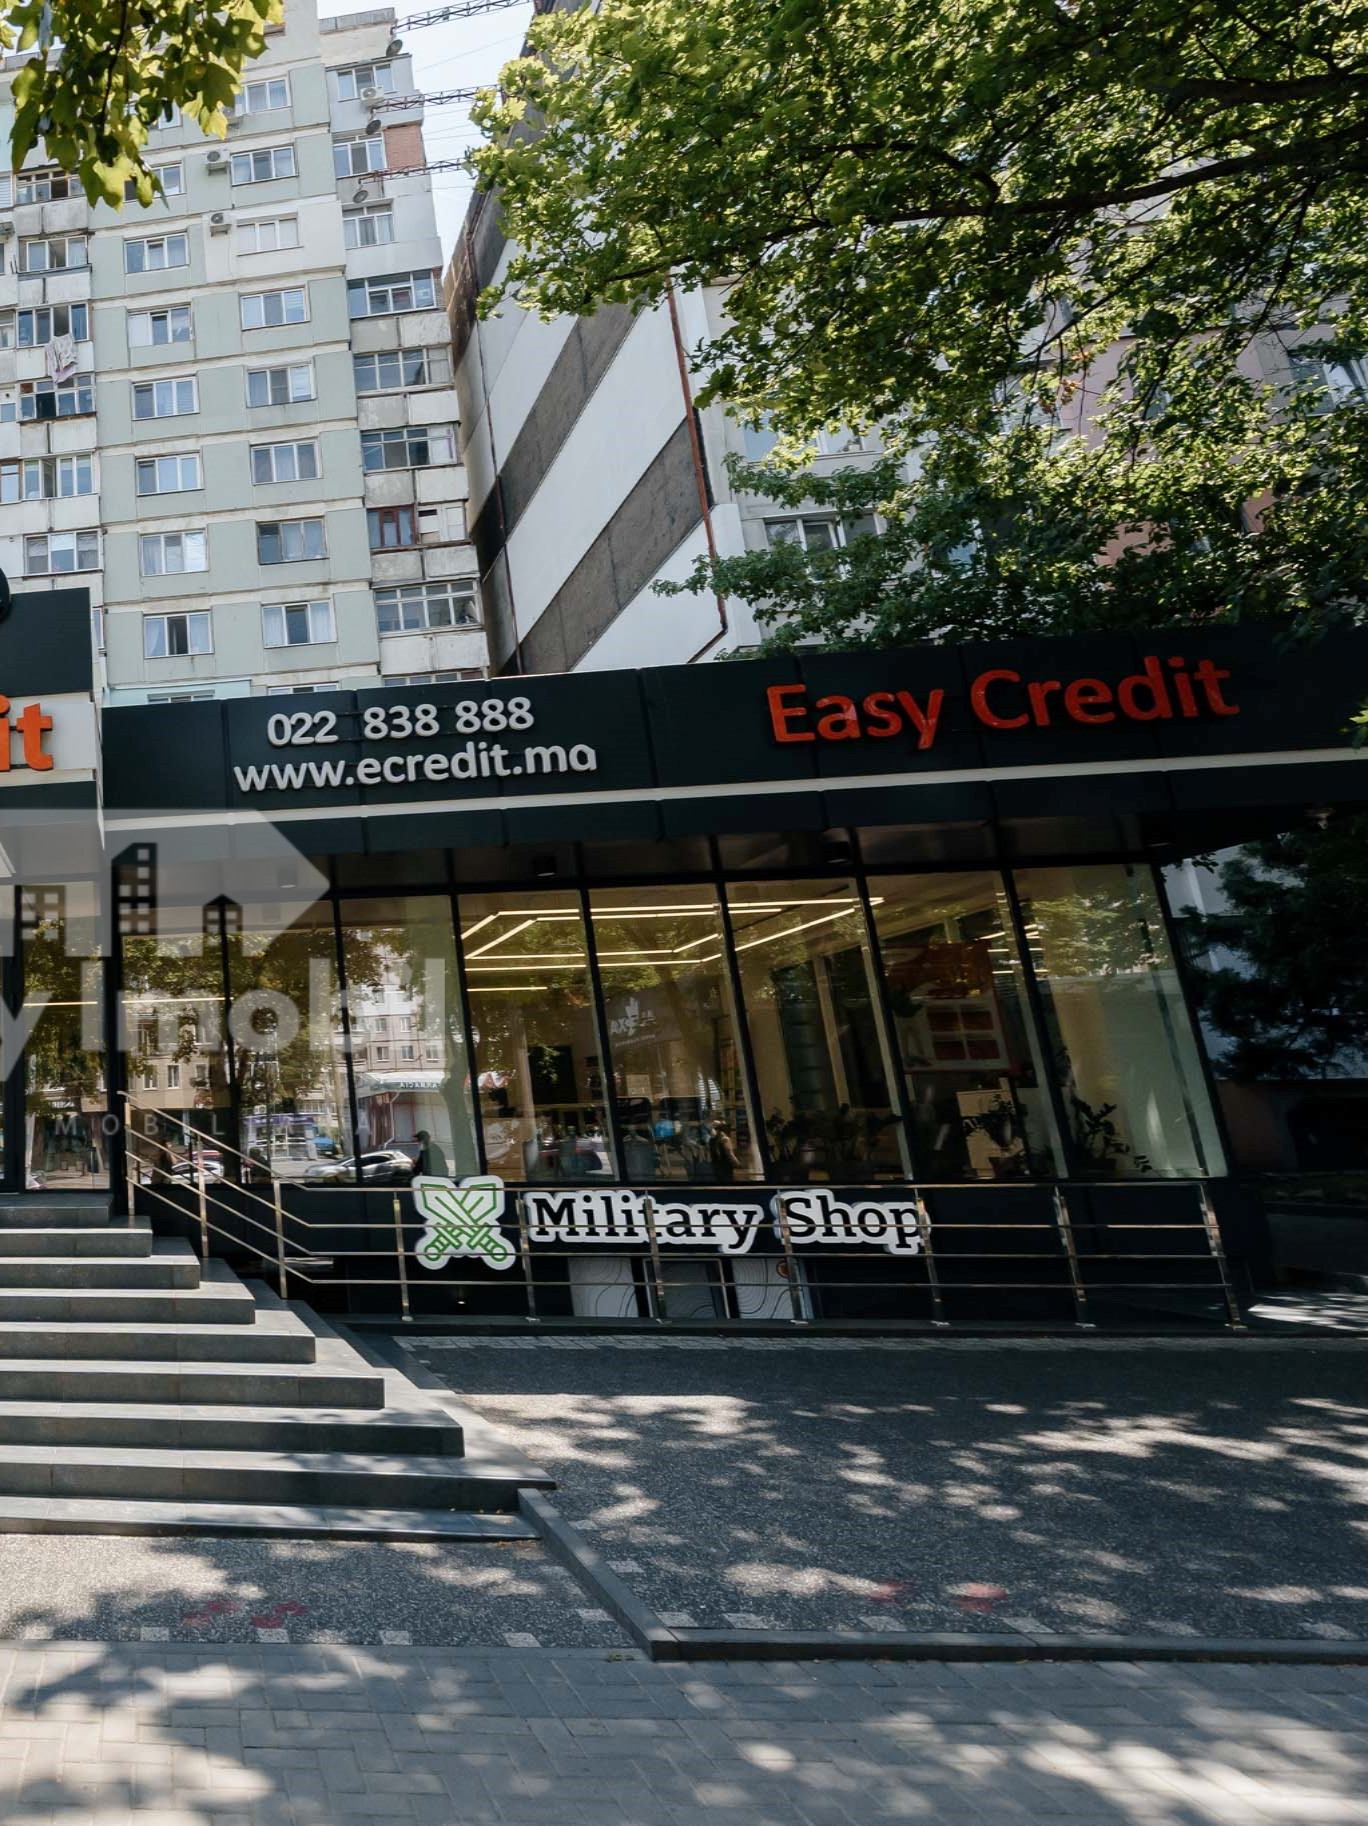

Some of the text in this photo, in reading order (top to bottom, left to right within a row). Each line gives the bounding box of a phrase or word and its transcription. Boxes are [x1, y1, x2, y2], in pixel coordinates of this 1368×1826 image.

[267, 696, 533, 746] 022 838 888
[765, 655, 1240, 749] Easy Credit
[532, 1194, 926, 1250] Military Shop
